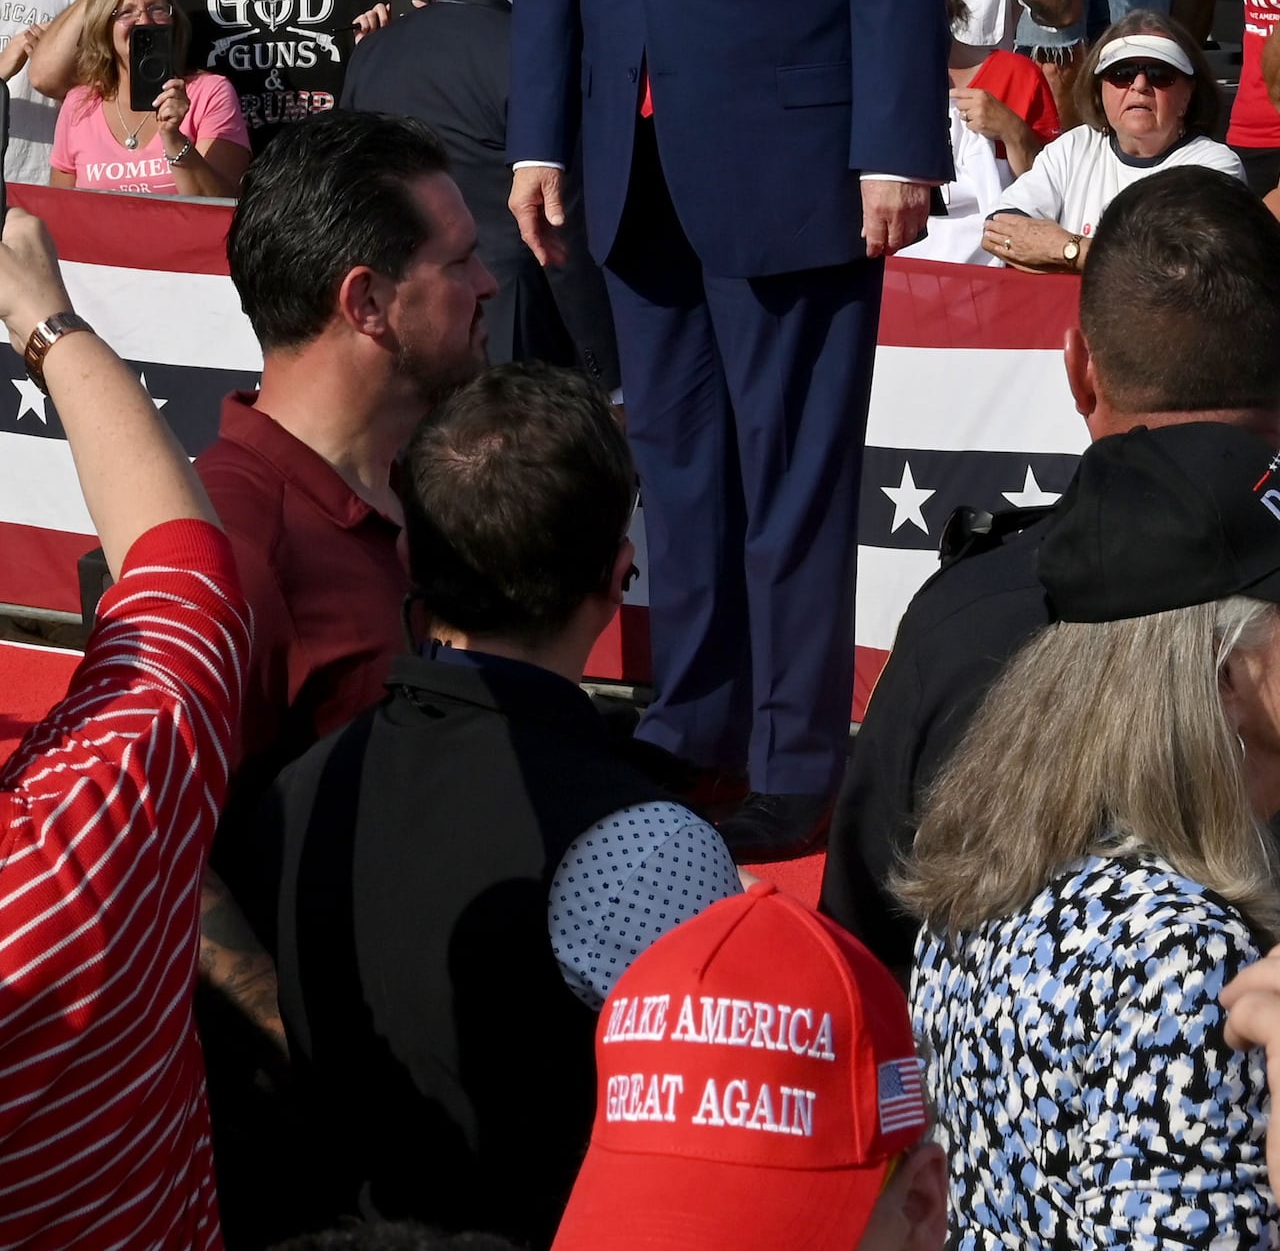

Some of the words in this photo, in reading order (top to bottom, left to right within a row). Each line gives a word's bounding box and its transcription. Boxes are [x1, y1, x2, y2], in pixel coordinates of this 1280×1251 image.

[228, 42, 318, 69] GUNS
[264, 68, 285, 91] &
[604, 994, 670, 1045] MAKE
[671, 994, 836, 1061] AMERICA
[606, 1074, 683, 1124] GREAT
[691, 1077, 817, 1137] AGAIN
